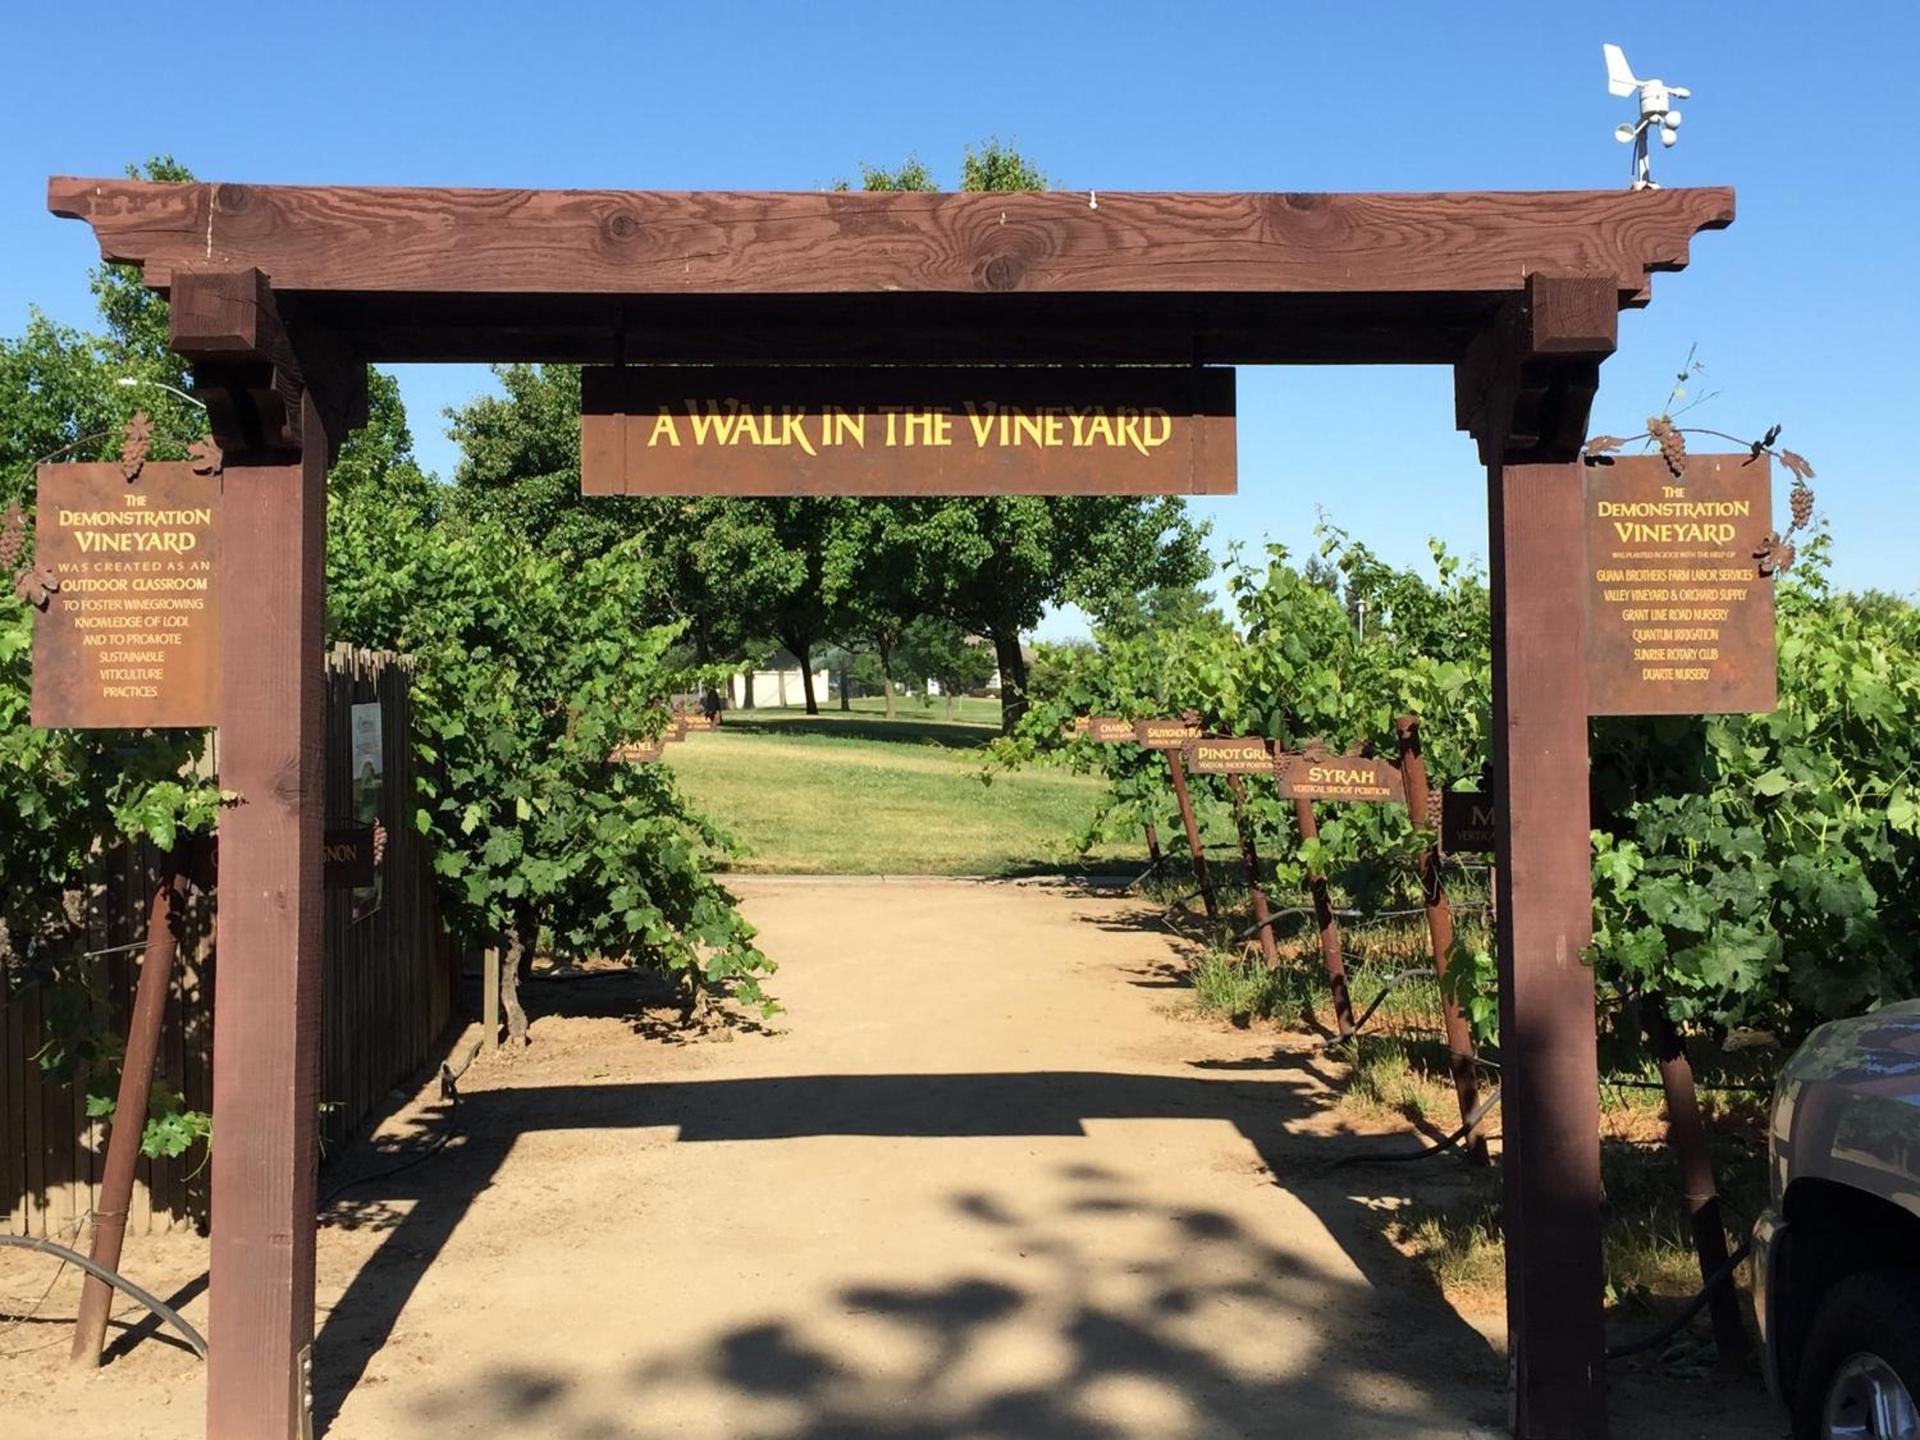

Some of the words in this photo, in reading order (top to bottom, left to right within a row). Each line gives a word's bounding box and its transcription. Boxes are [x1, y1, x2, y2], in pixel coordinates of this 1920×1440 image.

[647, 405, 681, 446] A
[684, 397, 817, 456] WALK
[822, 405, 865, 448] IN
[878, 405, 952, 446] THE
[963, 400, 1172, 456] VINEYARD
[1662, 486, 1686, 498] THE
[124, 494, 147, 507] THE
[1598, 501, 1750, 519] DEMONSTRATION
[59, 509, 211, 528] DEMONSTRATION
[1614, 522, 1736, 546] VINEYARD
[74, 531, 196, 555] VINEYARD
[58, 562, 89, 573] WAS
[94, 561, 162, 573] CREATED
[167, 561, 184, 572] AS
[190, 560, 210, 571] AN
[1625, 569, 1667, 582] BROTHERS
[1668, 569, 1690, 582] FARM
[1719, 569, 1753, 582] SERVICES
[60, 578, 127, 592] OUTDOOR
[132, 577, 208, 591] CLASSROOM
[1604, 589, 1630, 602] VALLEY
[1631, 589, 1669, 602] VINEYARD
[1679, 589, 1718, 601] ORCHARD
[1719, 589, 1747, 601] SUPPLY
[63, 599, 79, 611] TO
[81, 599, 122, 611] FOSTER
[124, 598, 204, 611] WINEGROWING
[1622, 608, 1649, 621] GRANT
[1650, 608, 1668, 621] LINE
[1669, 608, 1693, 621] ROAD
[1694, 608, 1729, 621] NURSERY
[75, 616, 143, 628] KNOWLEDGE
[144, 616, 161, 627] OF
[83, 634, 106, 646] AND
[108, 634, 125, 645] TO
[127, 633, 182, 645] PROMOTE
[1632, 628, 1673, 643] QUANTUM
[1674, 628, 1719, 641] IRRIGATION
[100, 651, 164, 663] SUSTAINABLE
[1634, 648, 1666, 661] SUNRISE
[1667, 648, 1697, 660] ROTARY
[1698, 648, 1719, 660] CLUB
[100, 668, 164, 680] VITICULTURE
[1643, 668, 1674, 681] DUARTE
[1675, 668, 1710, 681] NURSERY
[1198, 747, 1240, 760] PINOT
[1309, 767, 1376, 784] SYRAH
[1292, 784, 1325, 795] VERTICAL
[1327, 785, 1352, 795] SHOOT
[1354, 786, 1391, 796] POSITION
